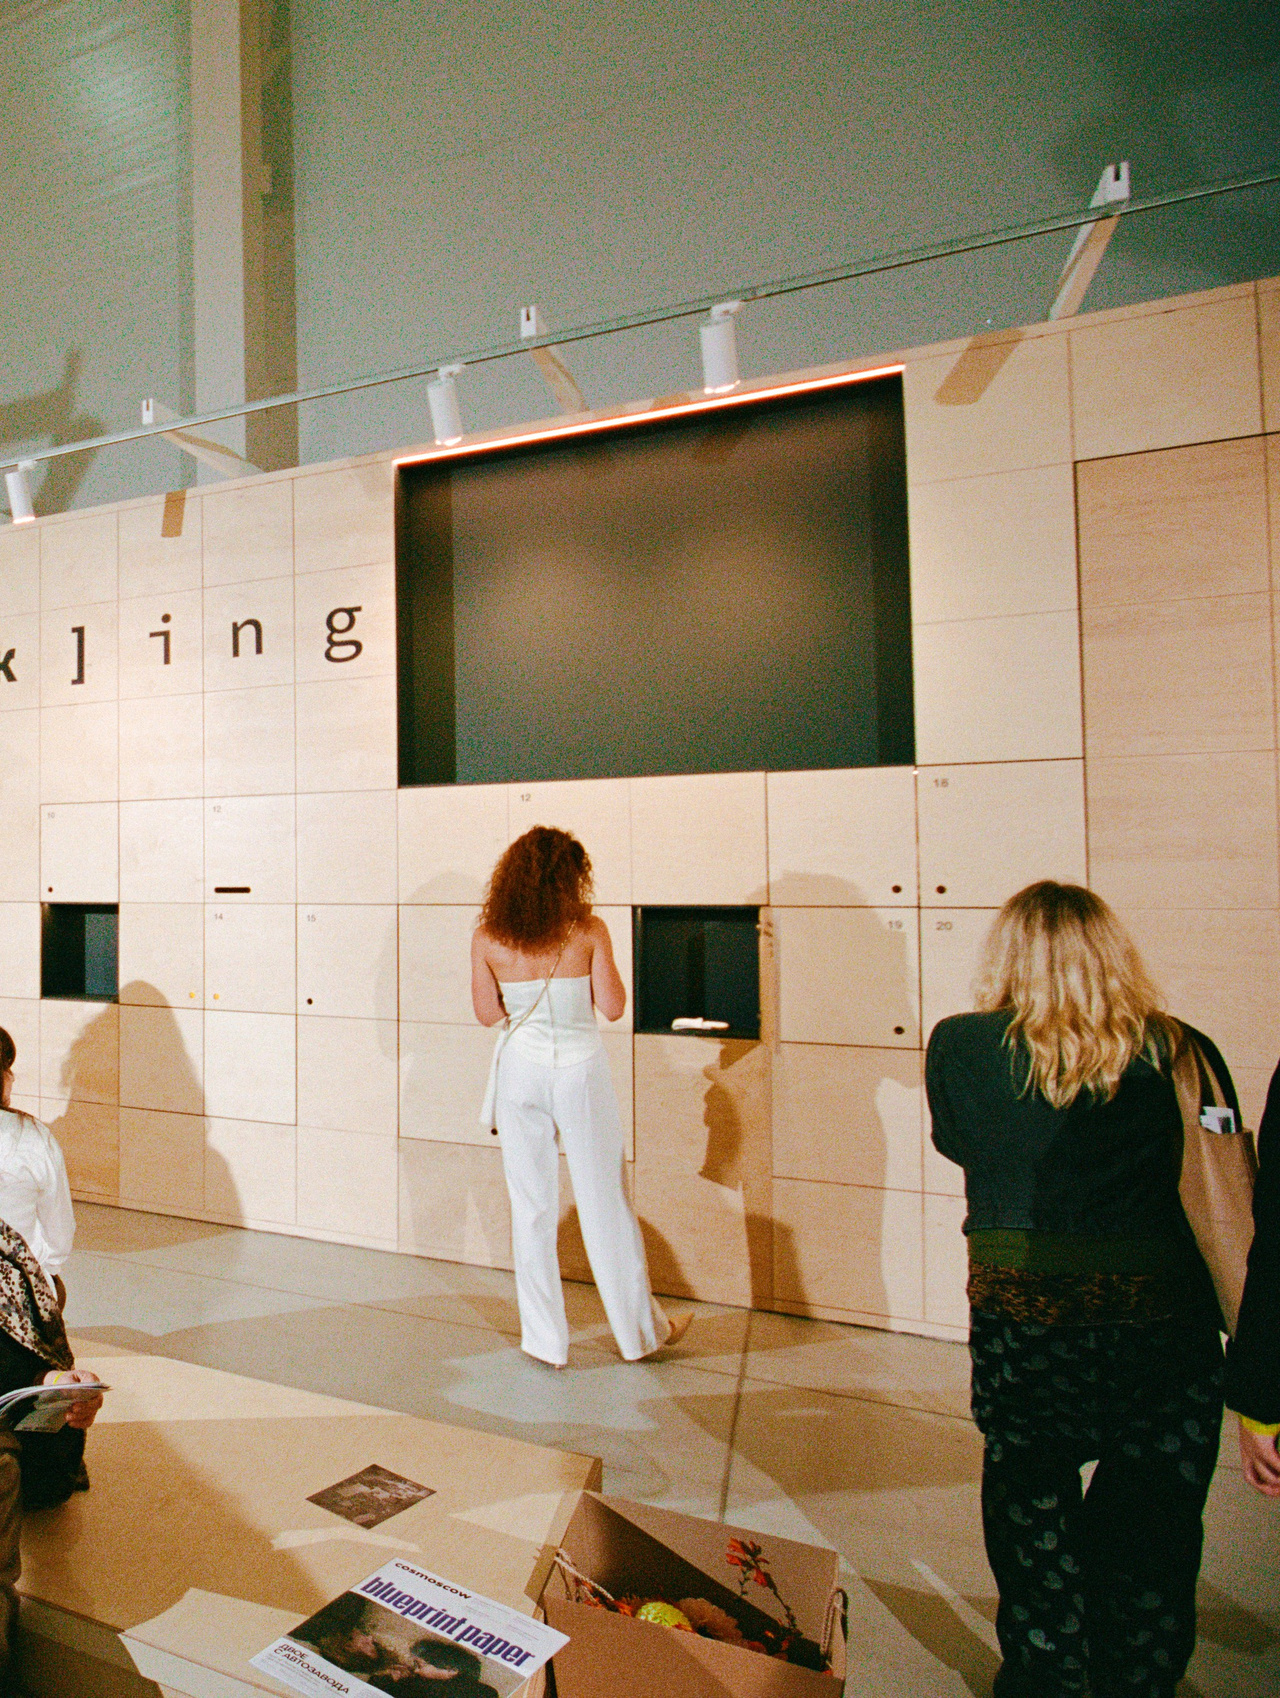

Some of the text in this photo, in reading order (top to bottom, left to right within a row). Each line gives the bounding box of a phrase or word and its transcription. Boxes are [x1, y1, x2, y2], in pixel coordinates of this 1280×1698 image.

[936, 921, 953, 931] 20
[394, 1562, 471, 1599] cosmoscow
[360, 1576, 468, 1635] blueprint
[453, 1624, 536, 1667] paper
[279, 1643, 309, 1660] ДВОЕ
[281, 1651, 350, 1695] АВТОЗАВОДА
